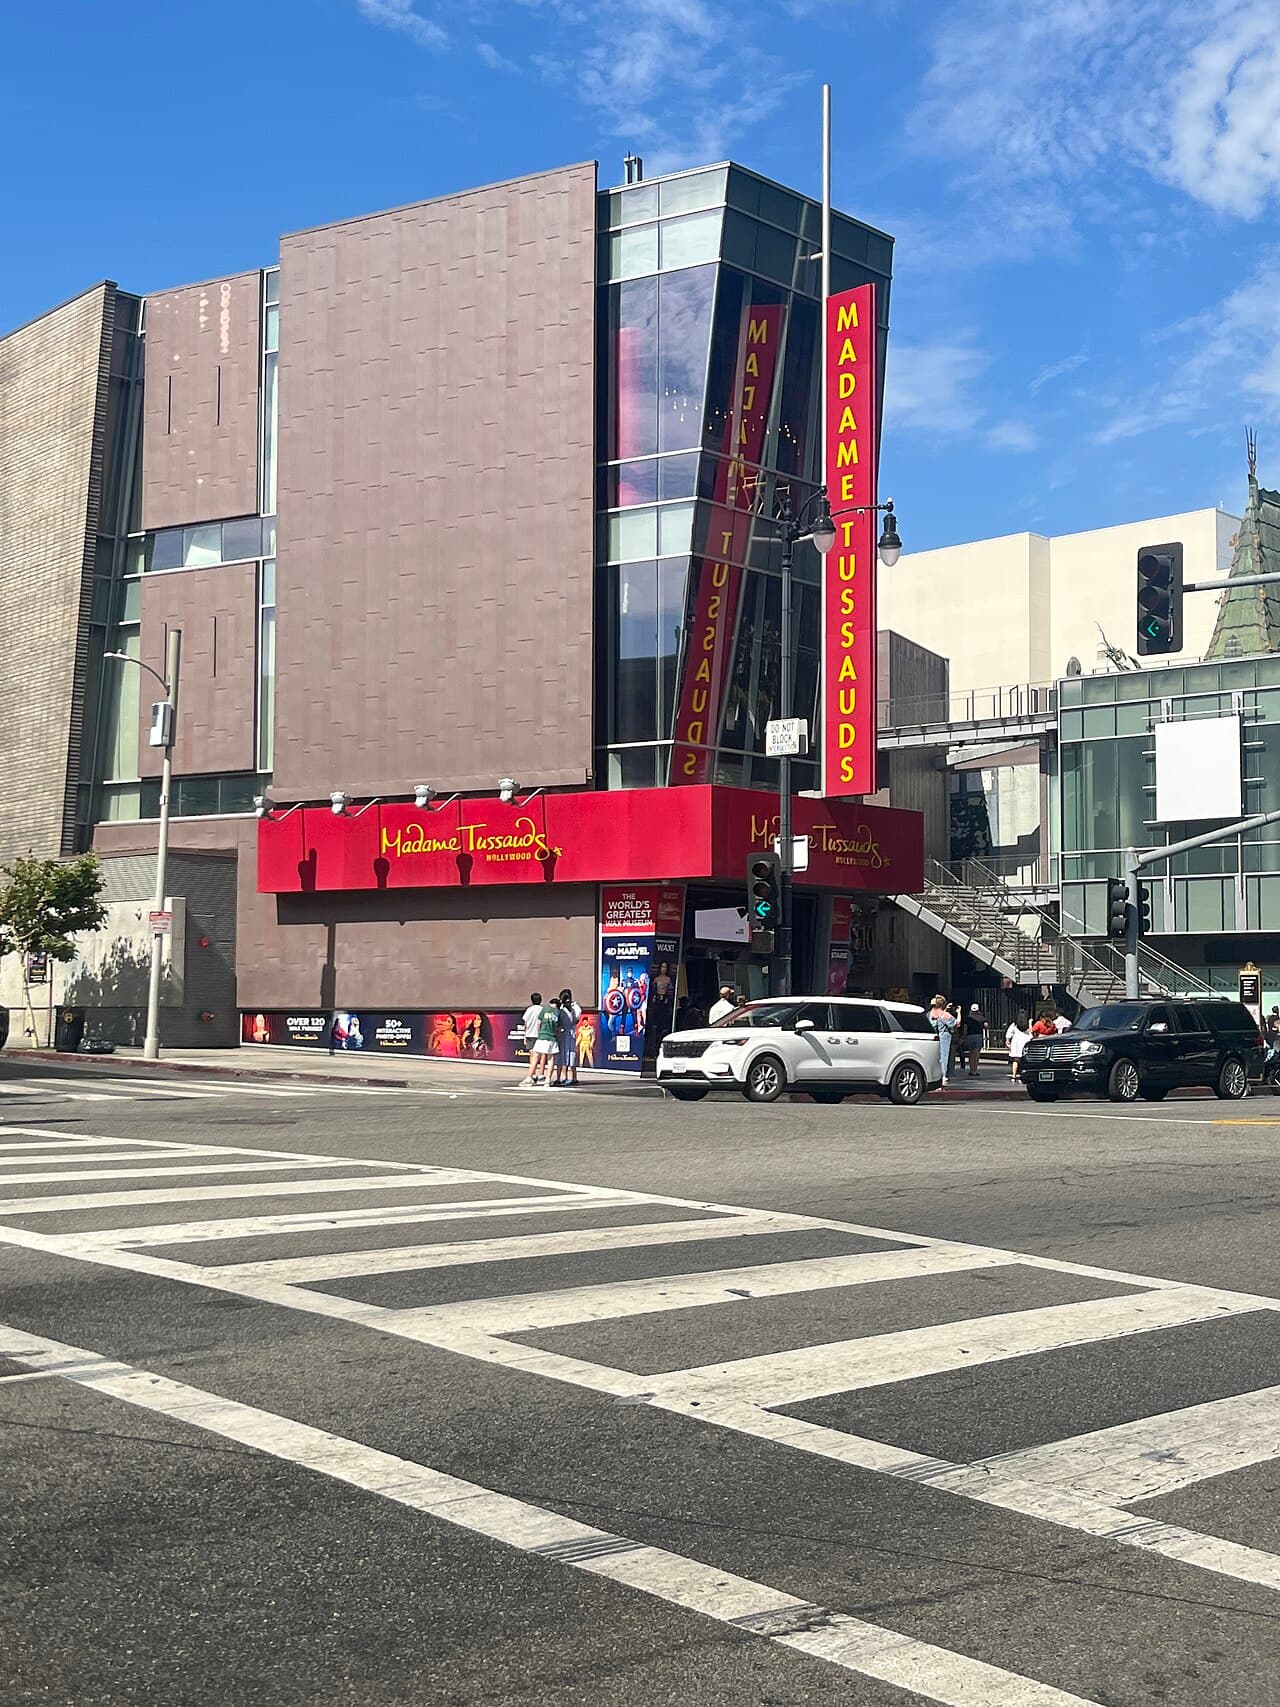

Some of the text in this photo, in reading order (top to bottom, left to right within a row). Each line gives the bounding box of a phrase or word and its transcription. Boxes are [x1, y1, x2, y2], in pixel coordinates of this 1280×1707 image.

[837, 303, 859, 782] MADAME TUSSAUDS
[771, 721, 795, 734] DO NOT
[772, 733, 792, 745] BLOCK
[381, 817, 550, 861] Madame Tussauds
[751, 814, 882, 869] Mae Tussauds
[486, 853, 532, 862] HOLLYWOOD
[608, 900, 650, 910] WORLD'S
[606, 909, 652, 919] GREATEST
[605, 919, 653, 927] WAX MUSEUM
[604, 947, 617, 956] 4D
[286, 1017, 326, 1026] OVER 120
[385, 1019, 403, 1028] 50+
